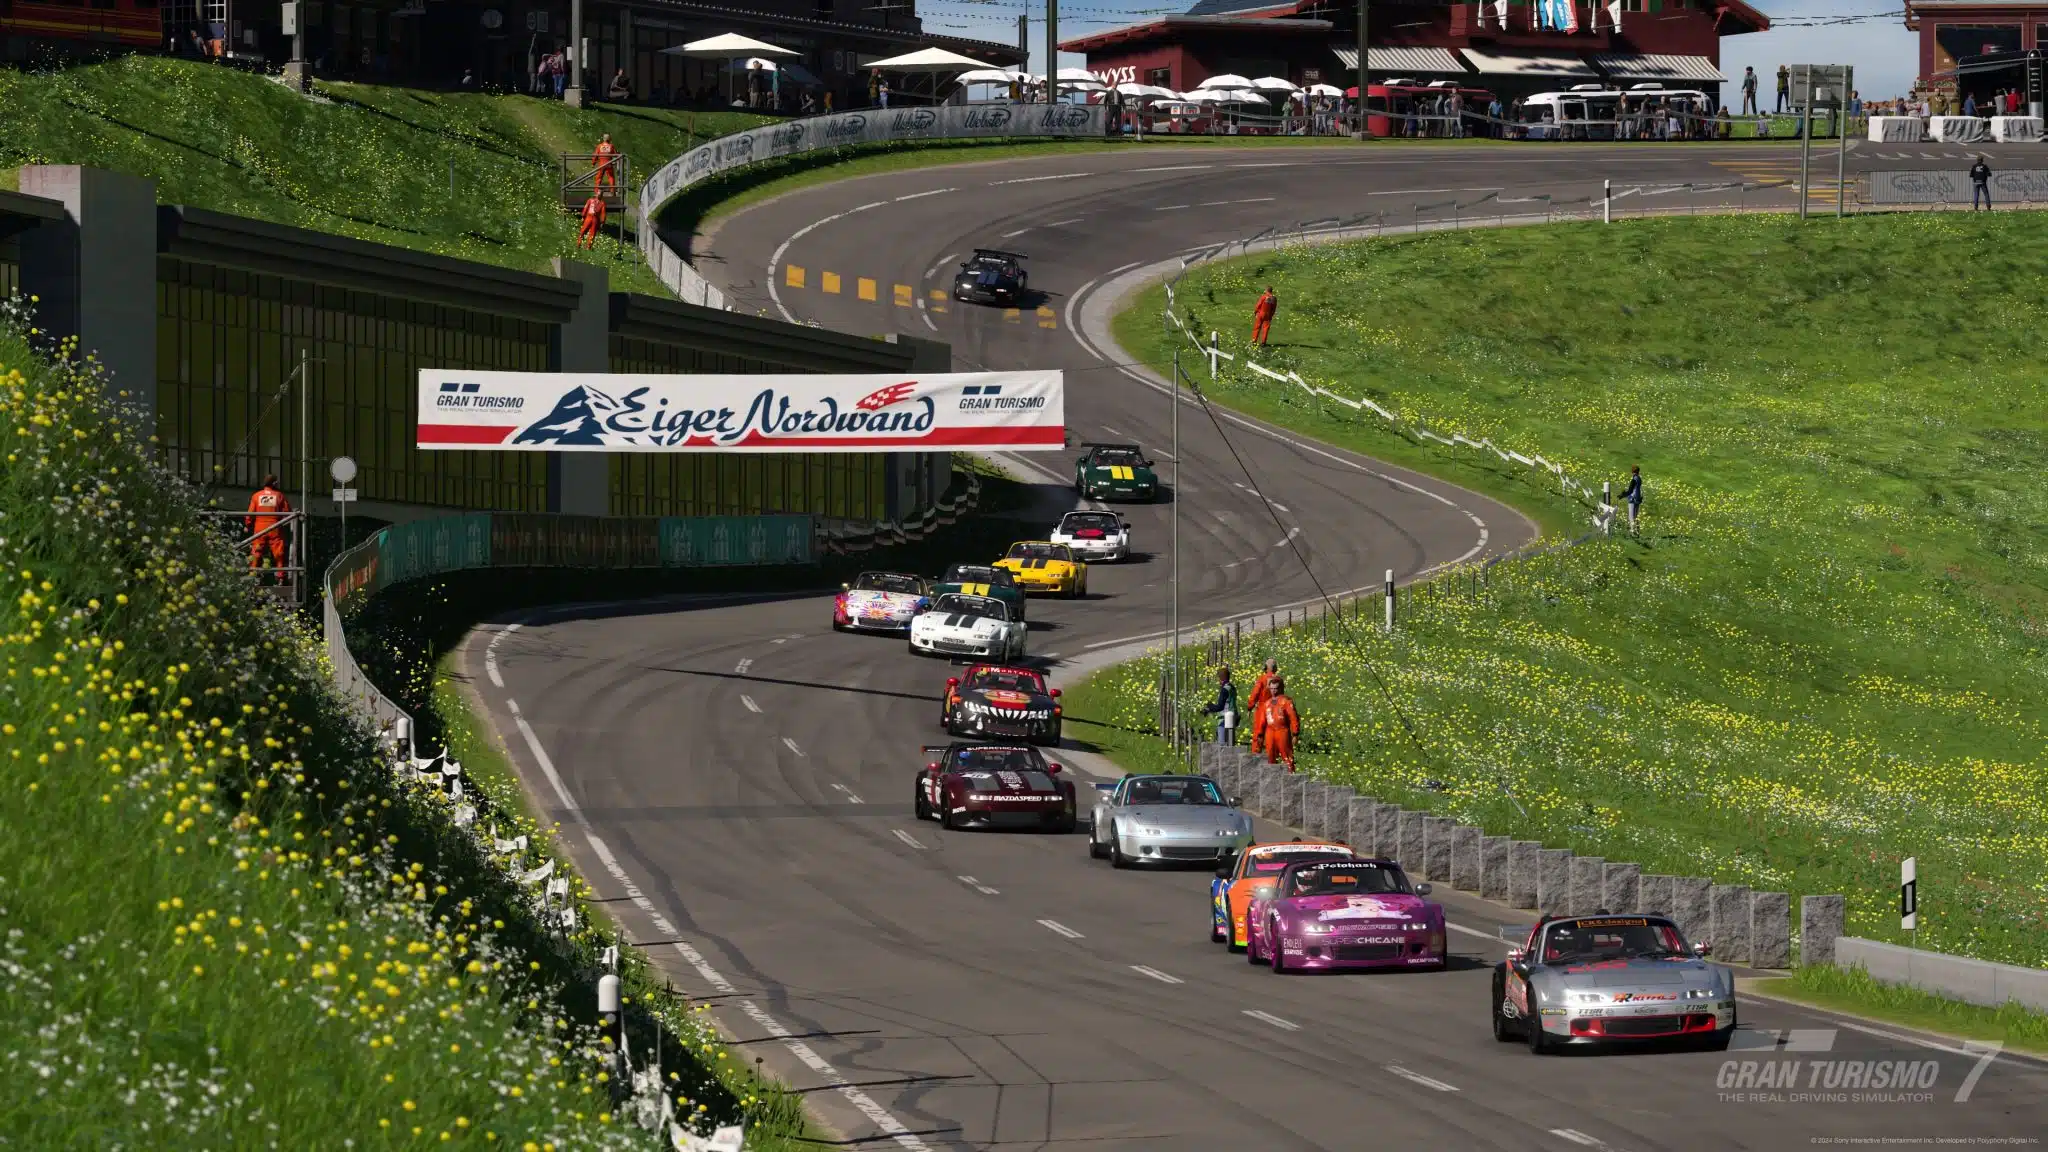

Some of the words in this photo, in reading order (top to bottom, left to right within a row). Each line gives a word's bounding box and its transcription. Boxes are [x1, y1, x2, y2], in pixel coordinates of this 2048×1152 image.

[1093, 66, 1136, 85] WYSS
[964, 108, 1011, 128] Webster
[1040, 108, 1089, 127] Webster
[437, 395, 468, 407] GRAN
[473, 396, 524, 408] TURISMO
[959, 398, 991, 409] GRAN
[994, 397, 1045, 408] TURISMO
[606, 387, 735, 446] Eiger
[720, 388, 935, 440] Nordwand
